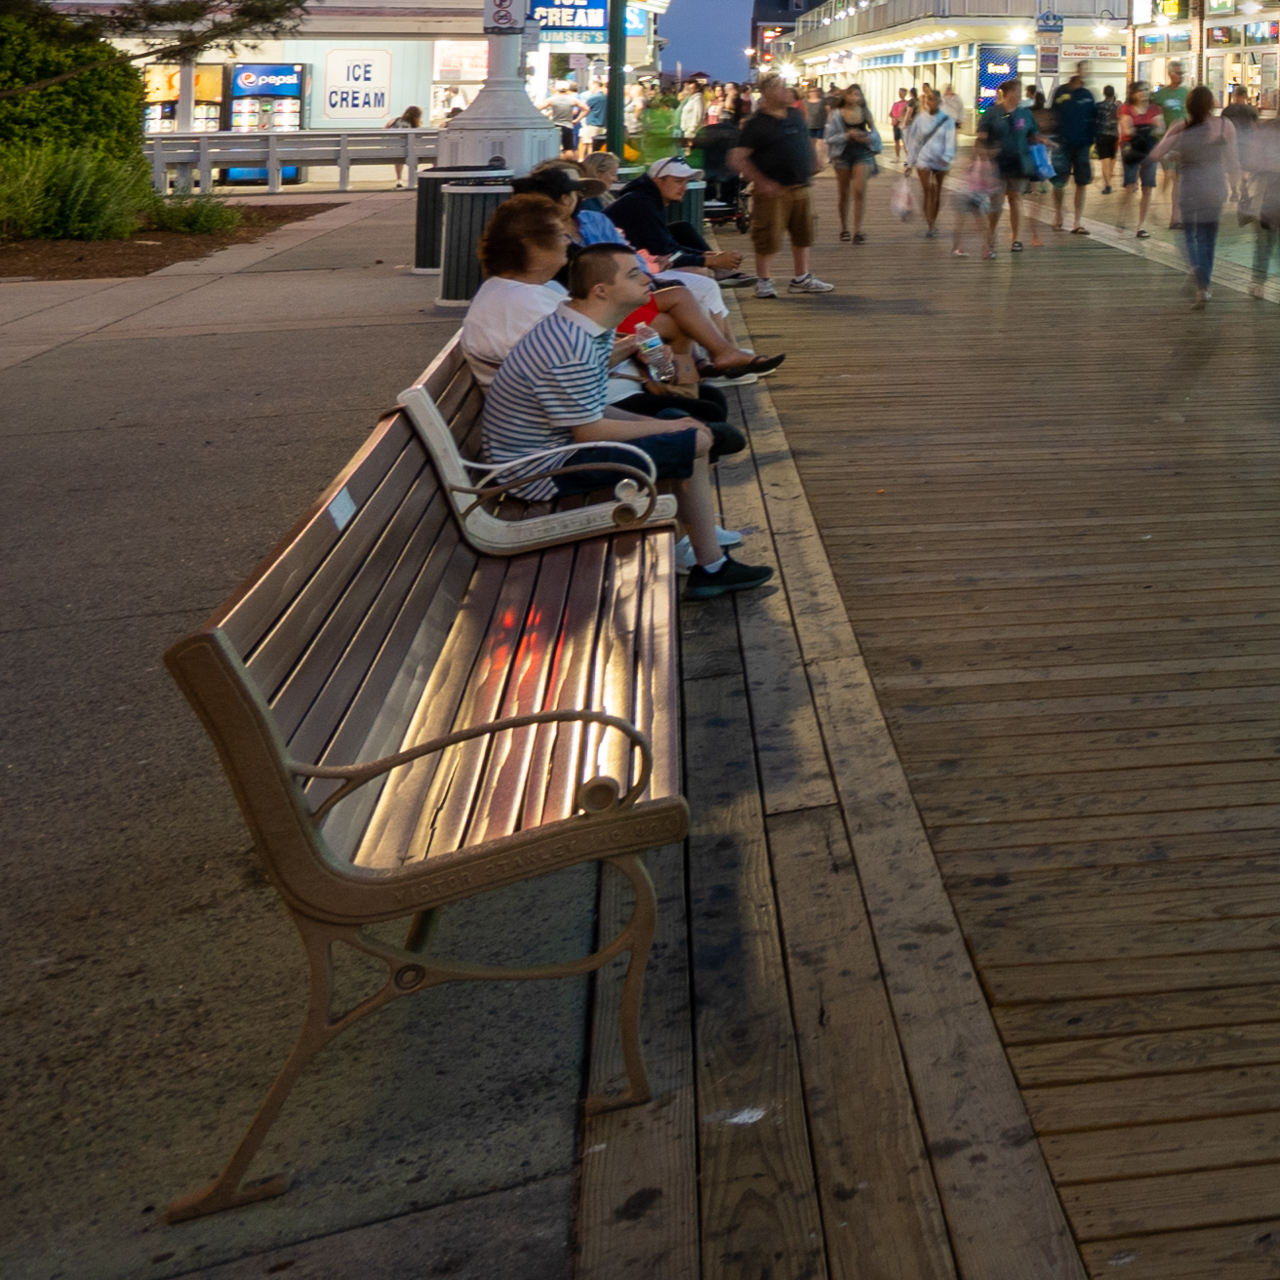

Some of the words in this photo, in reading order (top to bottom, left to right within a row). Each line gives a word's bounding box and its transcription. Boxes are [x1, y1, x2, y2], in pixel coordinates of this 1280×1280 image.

[534, 7, 605, 28] CREAM
[540, 30, 605, 43] UMSER'S
[257, 74, 299, 86] pepsi
[346, 60, 373, 82] ICE
[328, 87, 386, 108] CREAM
